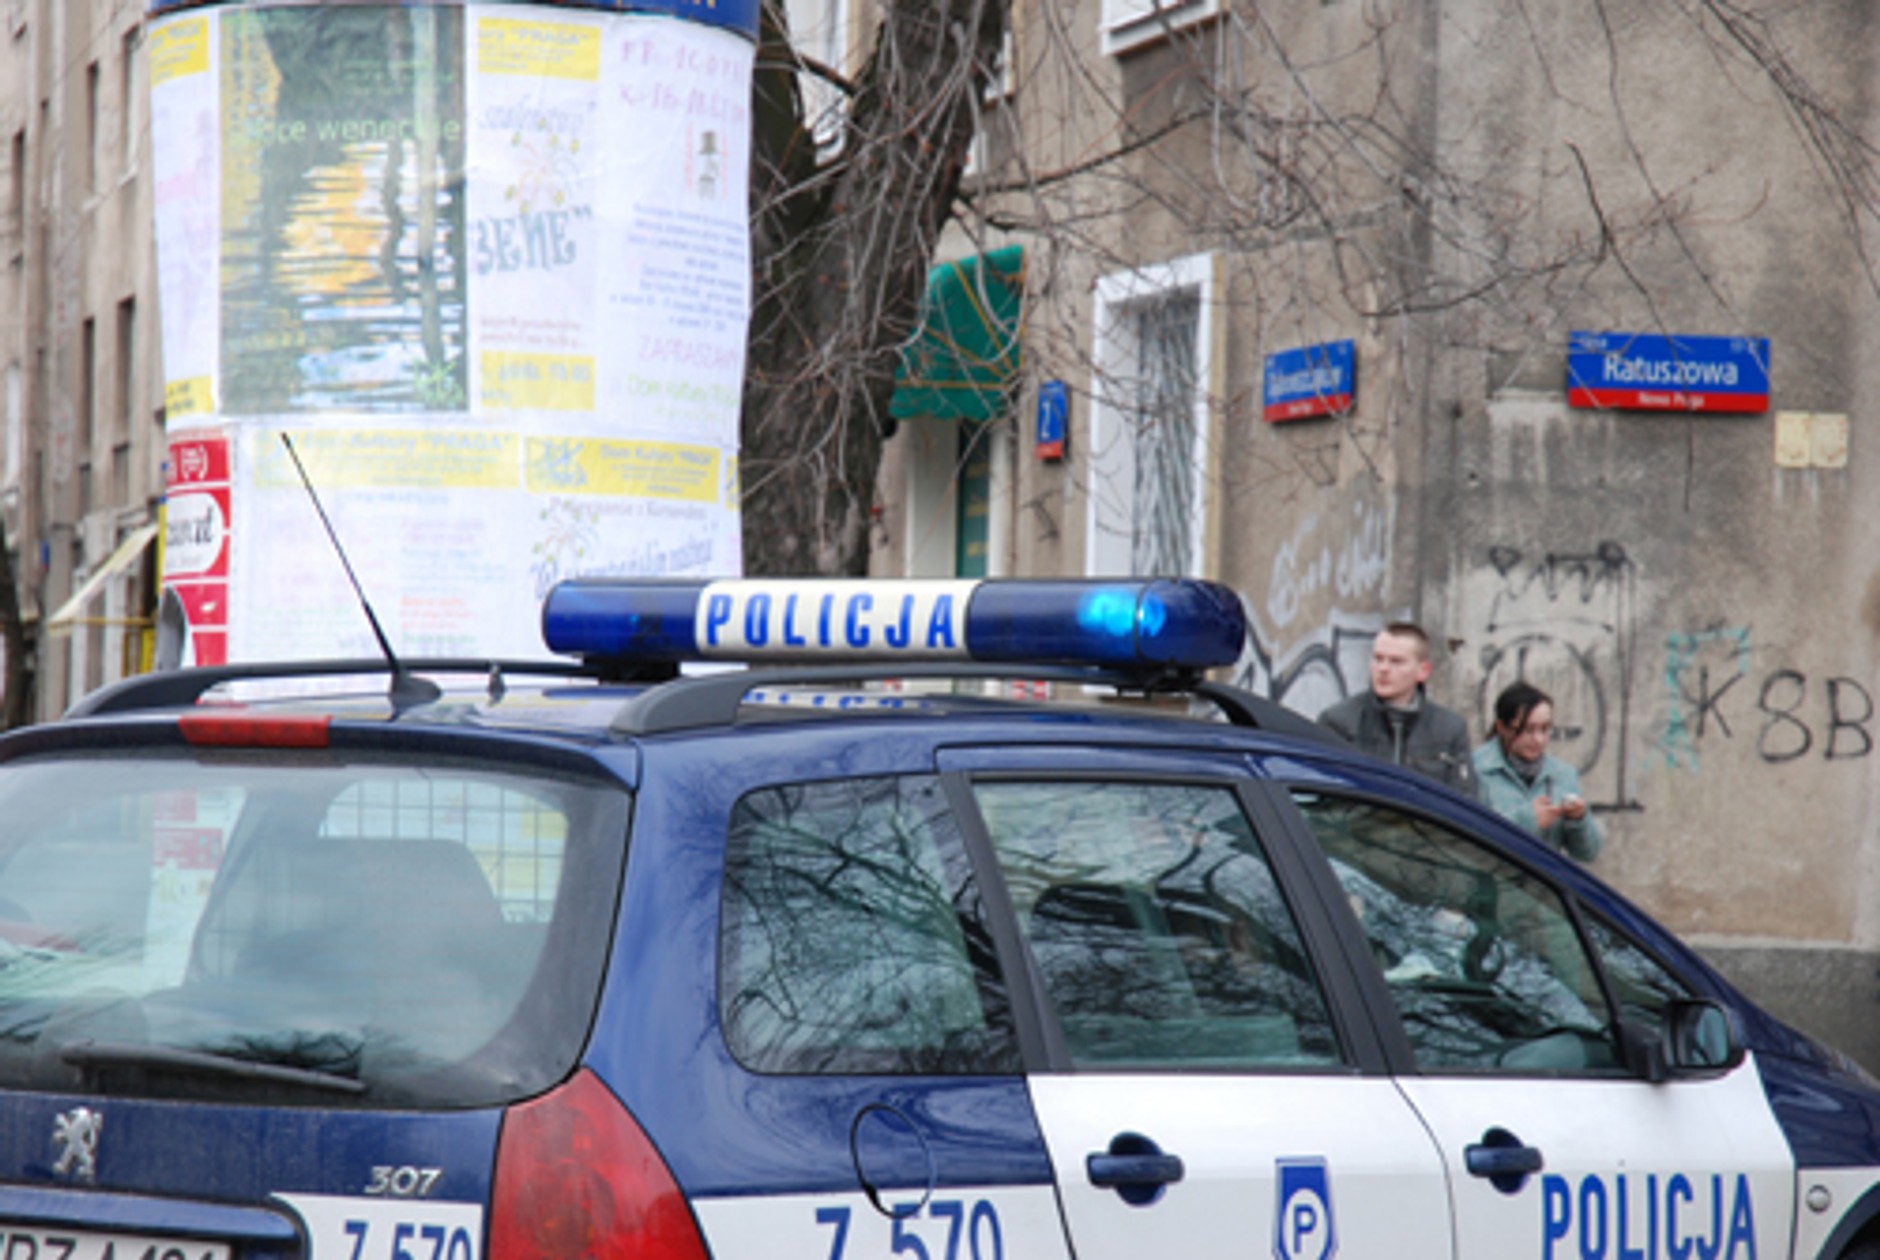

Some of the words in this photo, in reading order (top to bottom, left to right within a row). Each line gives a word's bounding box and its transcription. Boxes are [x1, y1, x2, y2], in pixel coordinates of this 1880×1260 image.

[1603, 353, 1739, 386] Ratuszowa
[706, 593, 956, 648] POLICJA
[364, 1165, 443, 1196] 307
[1293, 1203, 1317, 1254] P
[1542, 1173, 1758, 1260] POLICJA
